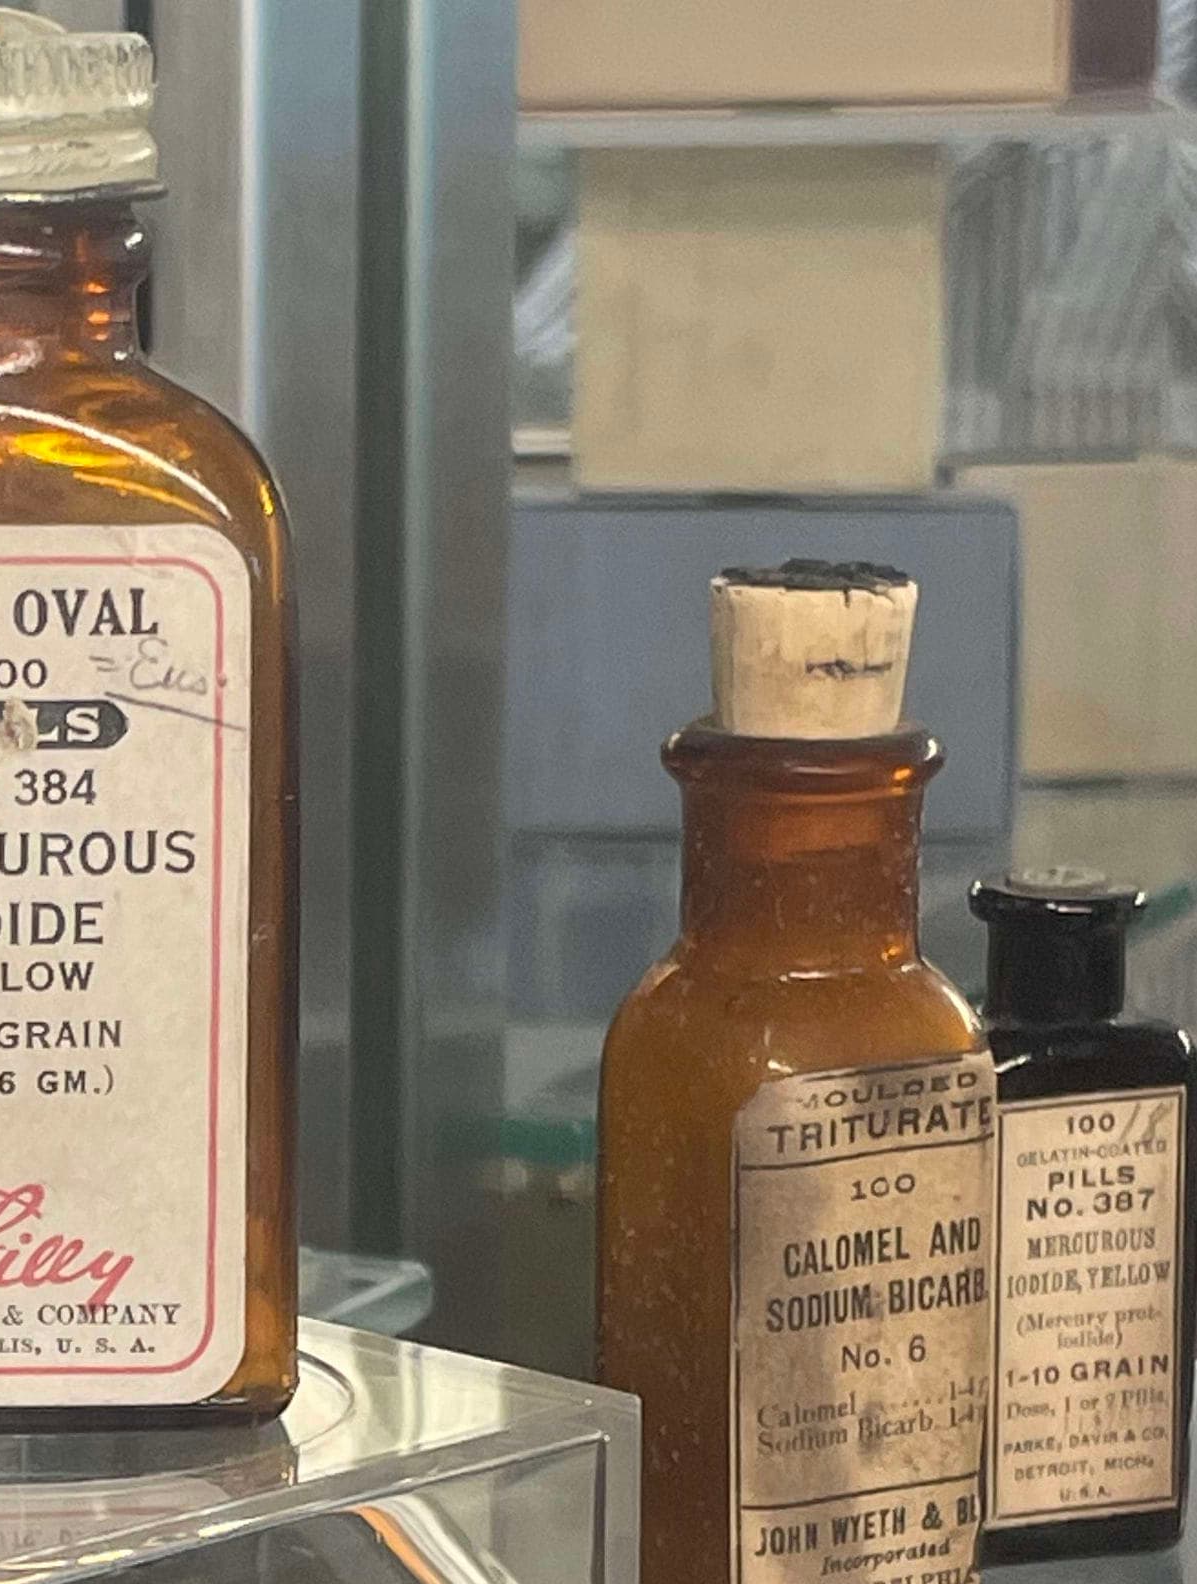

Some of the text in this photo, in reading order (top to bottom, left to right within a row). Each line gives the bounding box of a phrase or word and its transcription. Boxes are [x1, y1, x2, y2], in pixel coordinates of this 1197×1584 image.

[13, 587, 159, 637] OVAL
[13, 768, 97, 806] 384
[36, 1064, 115, 1096] GM.)
[1066, 1112, 1116, 1136] 100
[850, 1172, 916, 1202] 100
[1047, 1164, 1136, 1192] PILLS
[1025, 1187, 1155, 1222] NO. 387
[783, 1216, 982, 1280] CALOMEL AND
[1026, 1226, 1157, 1261] MERCUROUS
[1086, 1260, 1171, 1291] YELLOW
[1, 1304, 24, 1326] &
[36, 1302, 182, 1326] COMPANY
[765, 1283, 874, 1334] SODIUM
[56, 1338, 81, 1354] U.
[94, 1337, 116, 1353] S.
[129, 1337, 156, 1353] A.
[840, 1334, 927, 1373] No. 6
[1005, 1353, 1170, 1388] 1-10 GRAIN
[754, 1522, 819, 1557] JOHN
[831, 1506, 907, 1547] WYETH
[921, 1500, 943, 1531] &
[819, 1536, 952, 1577] Incorporated
